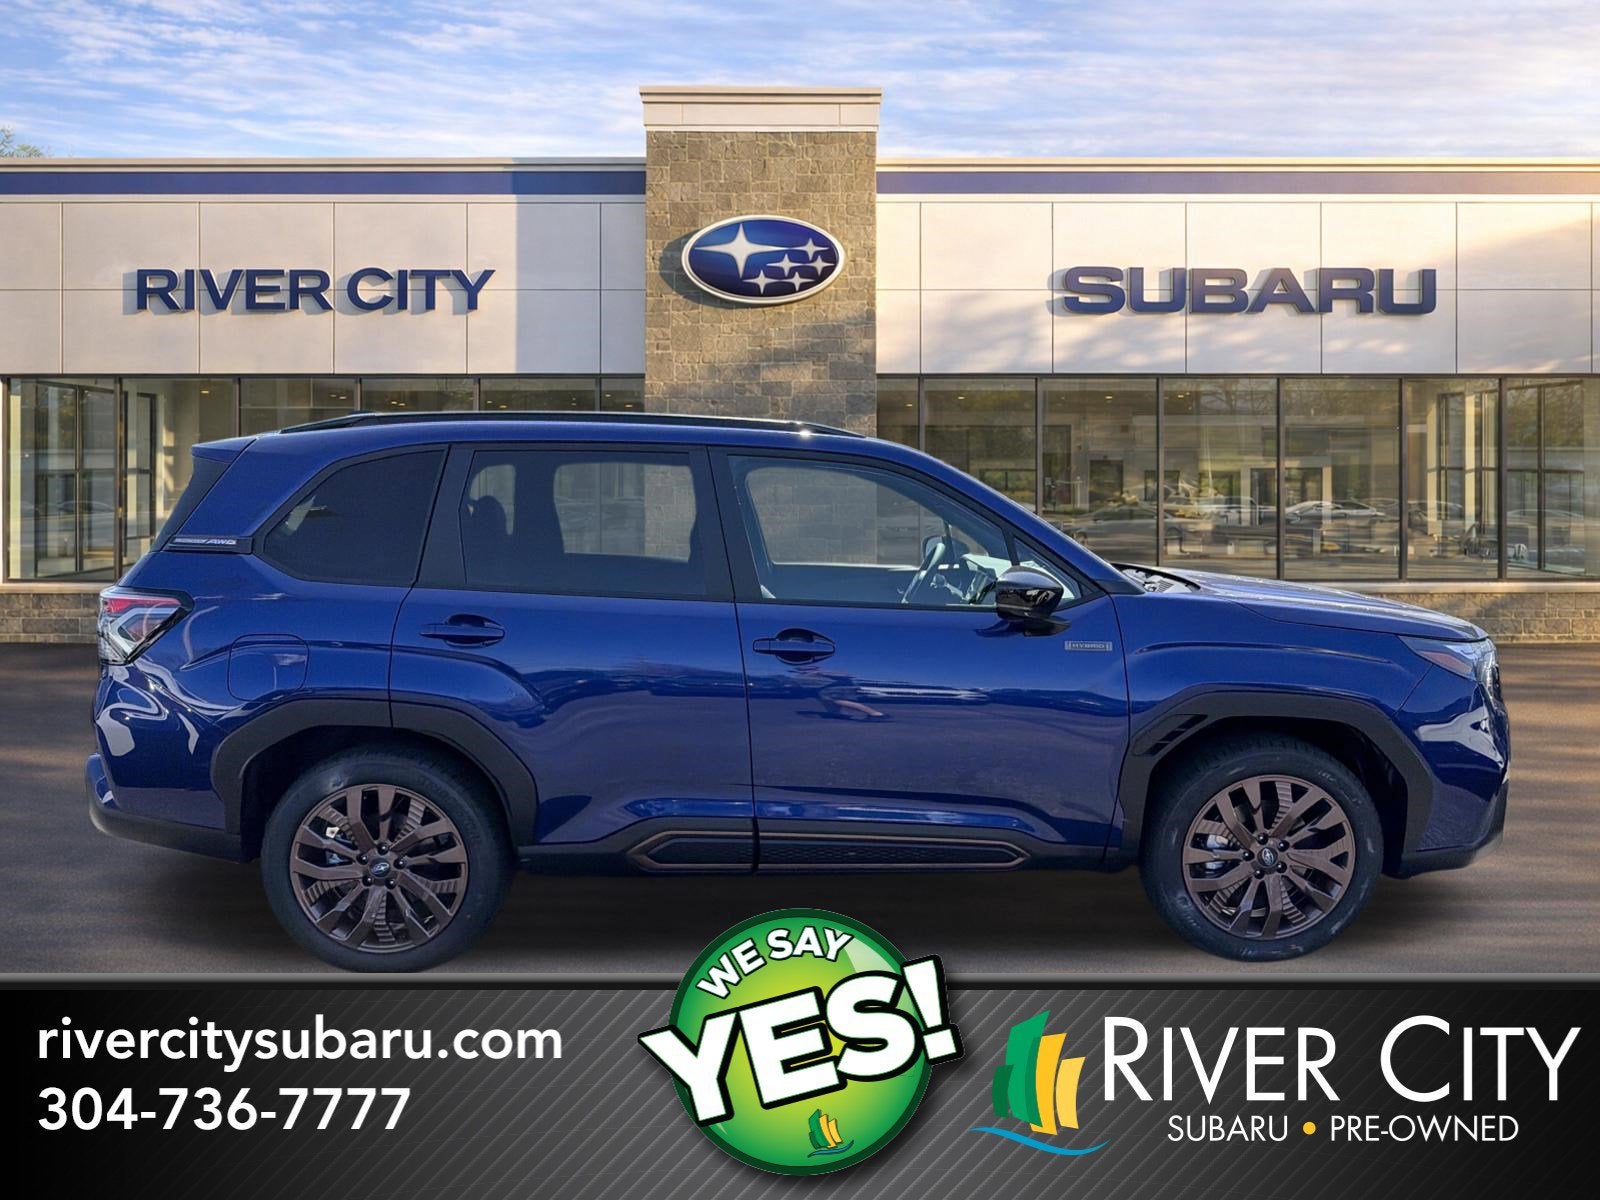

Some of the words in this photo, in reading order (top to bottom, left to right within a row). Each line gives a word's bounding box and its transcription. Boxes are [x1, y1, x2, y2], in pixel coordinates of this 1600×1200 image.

[136, 269, 332, 311] RIVER
[347, 267, 496, 312] CITY
[1062, 267, 1437, 315] SUBARU
